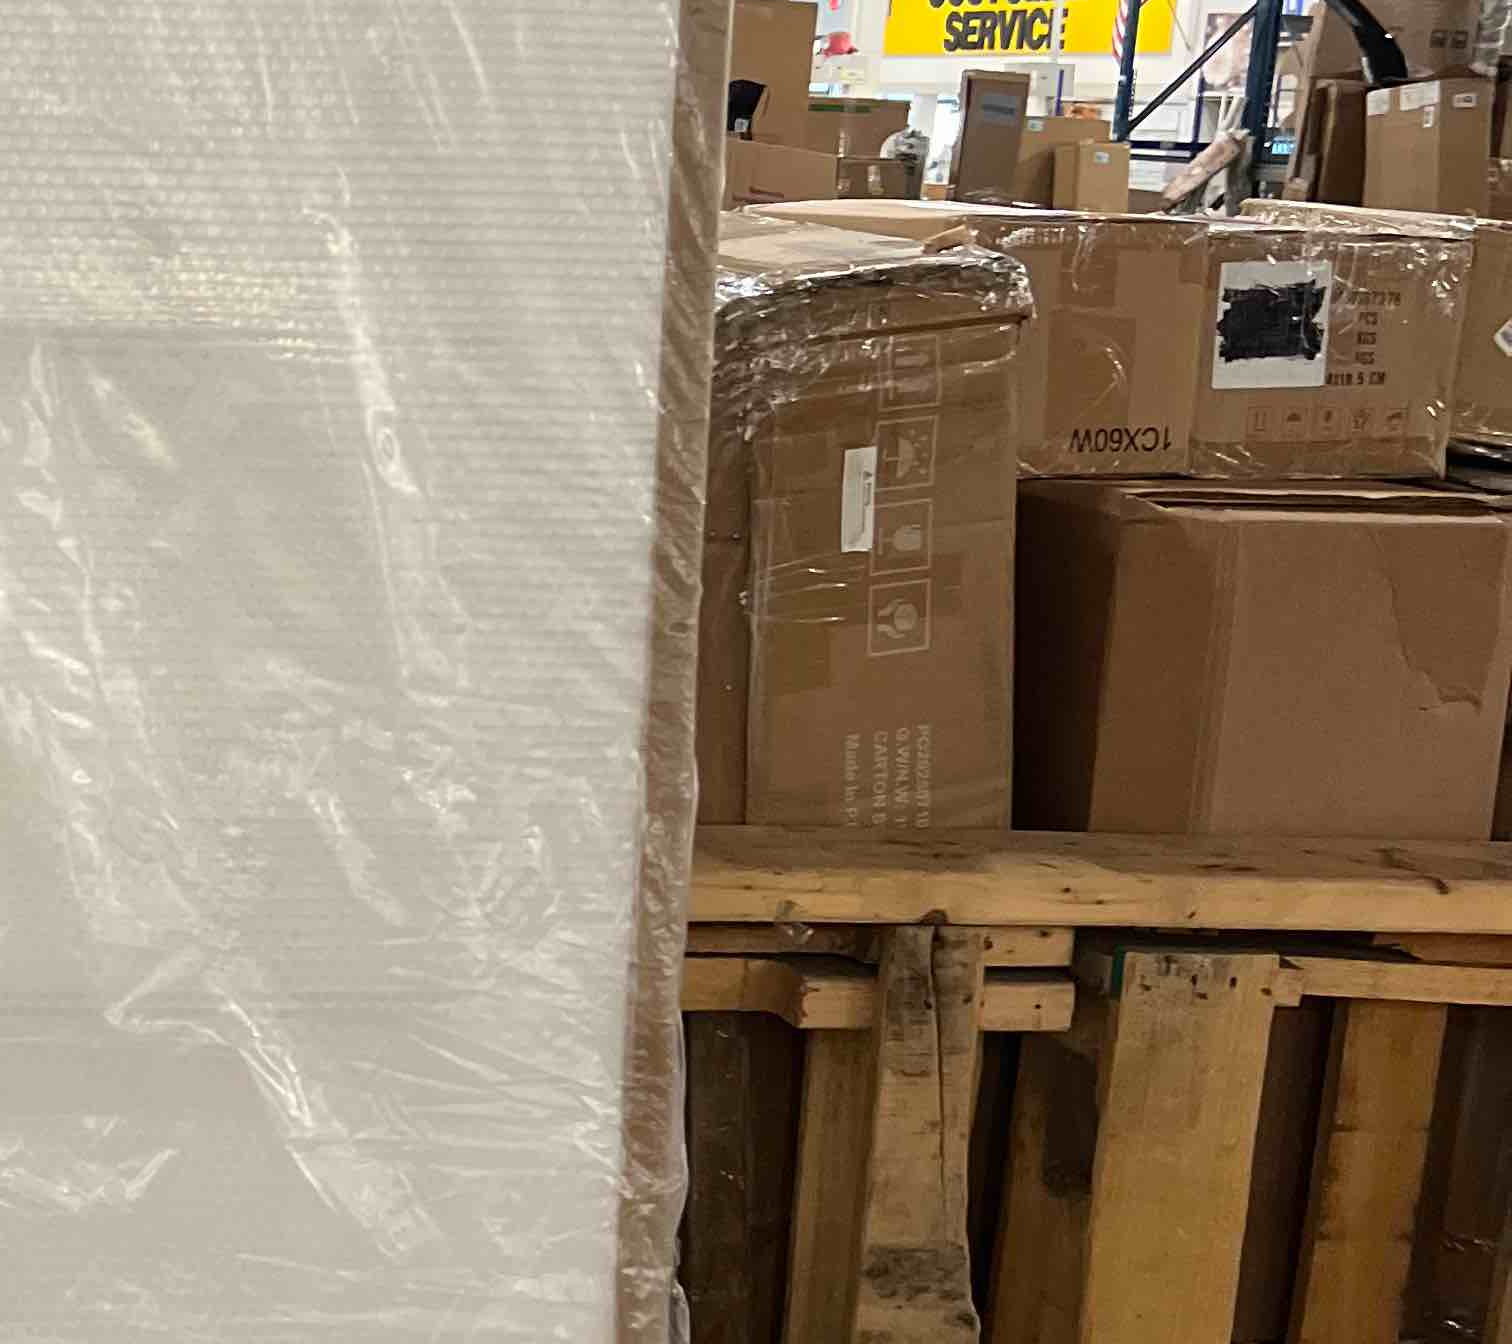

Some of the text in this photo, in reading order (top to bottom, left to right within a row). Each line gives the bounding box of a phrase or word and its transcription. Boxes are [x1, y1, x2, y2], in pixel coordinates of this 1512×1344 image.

[943, 9, 1069, 52] SERVICE
[1070, 425, 1172, 453] 1CX60W
[872, 731, 888, 807] CARTON
